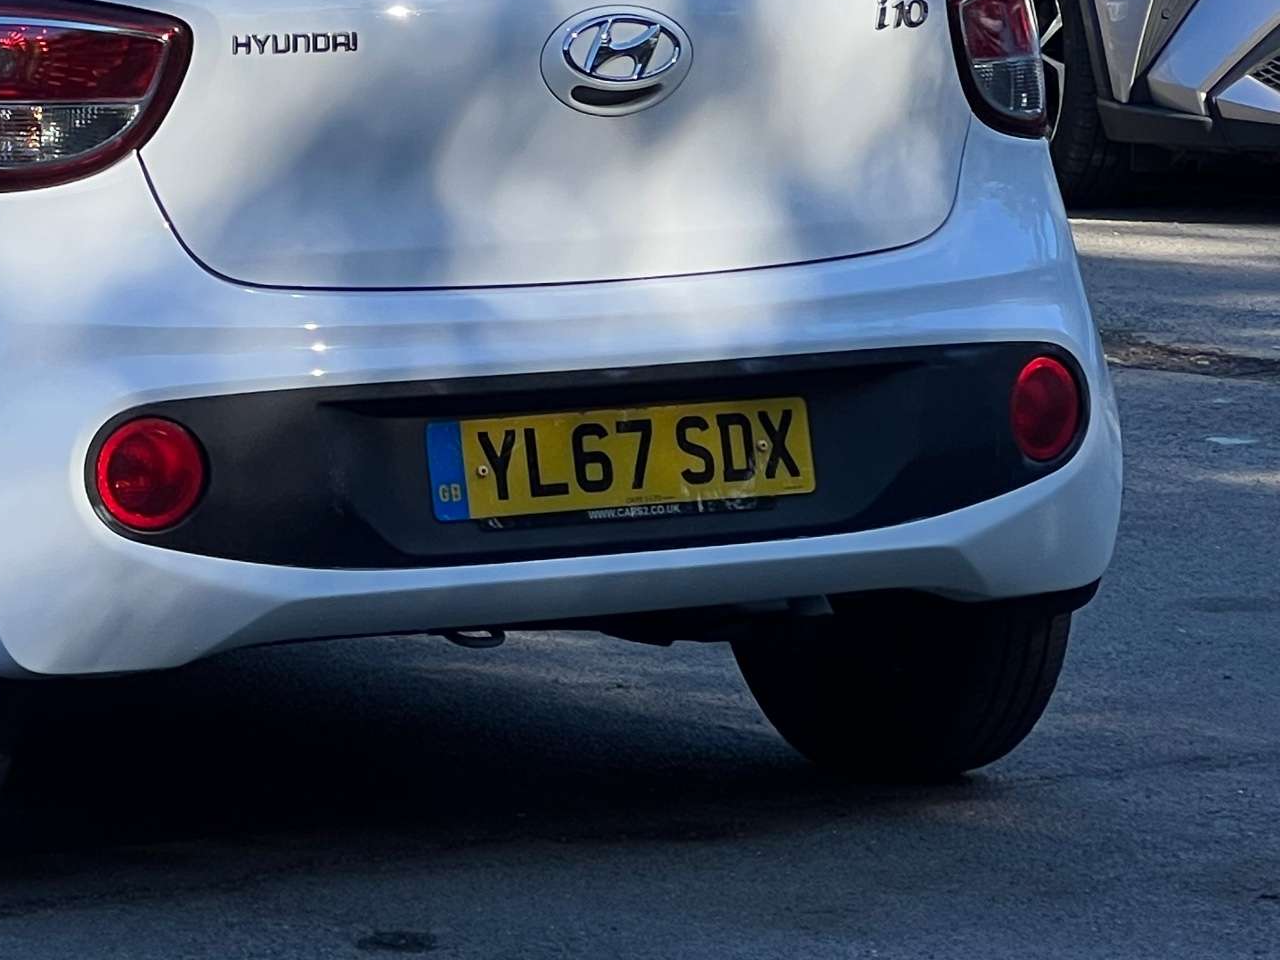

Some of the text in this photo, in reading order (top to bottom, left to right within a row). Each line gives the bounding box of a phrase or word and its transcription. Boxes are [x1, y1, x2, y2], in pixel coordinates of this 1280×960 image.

[232, 31, 358, 55] HYUNDAI
[477, 408, 801, 501] YL67 SDX
[439, 483, 462, 502] GB
